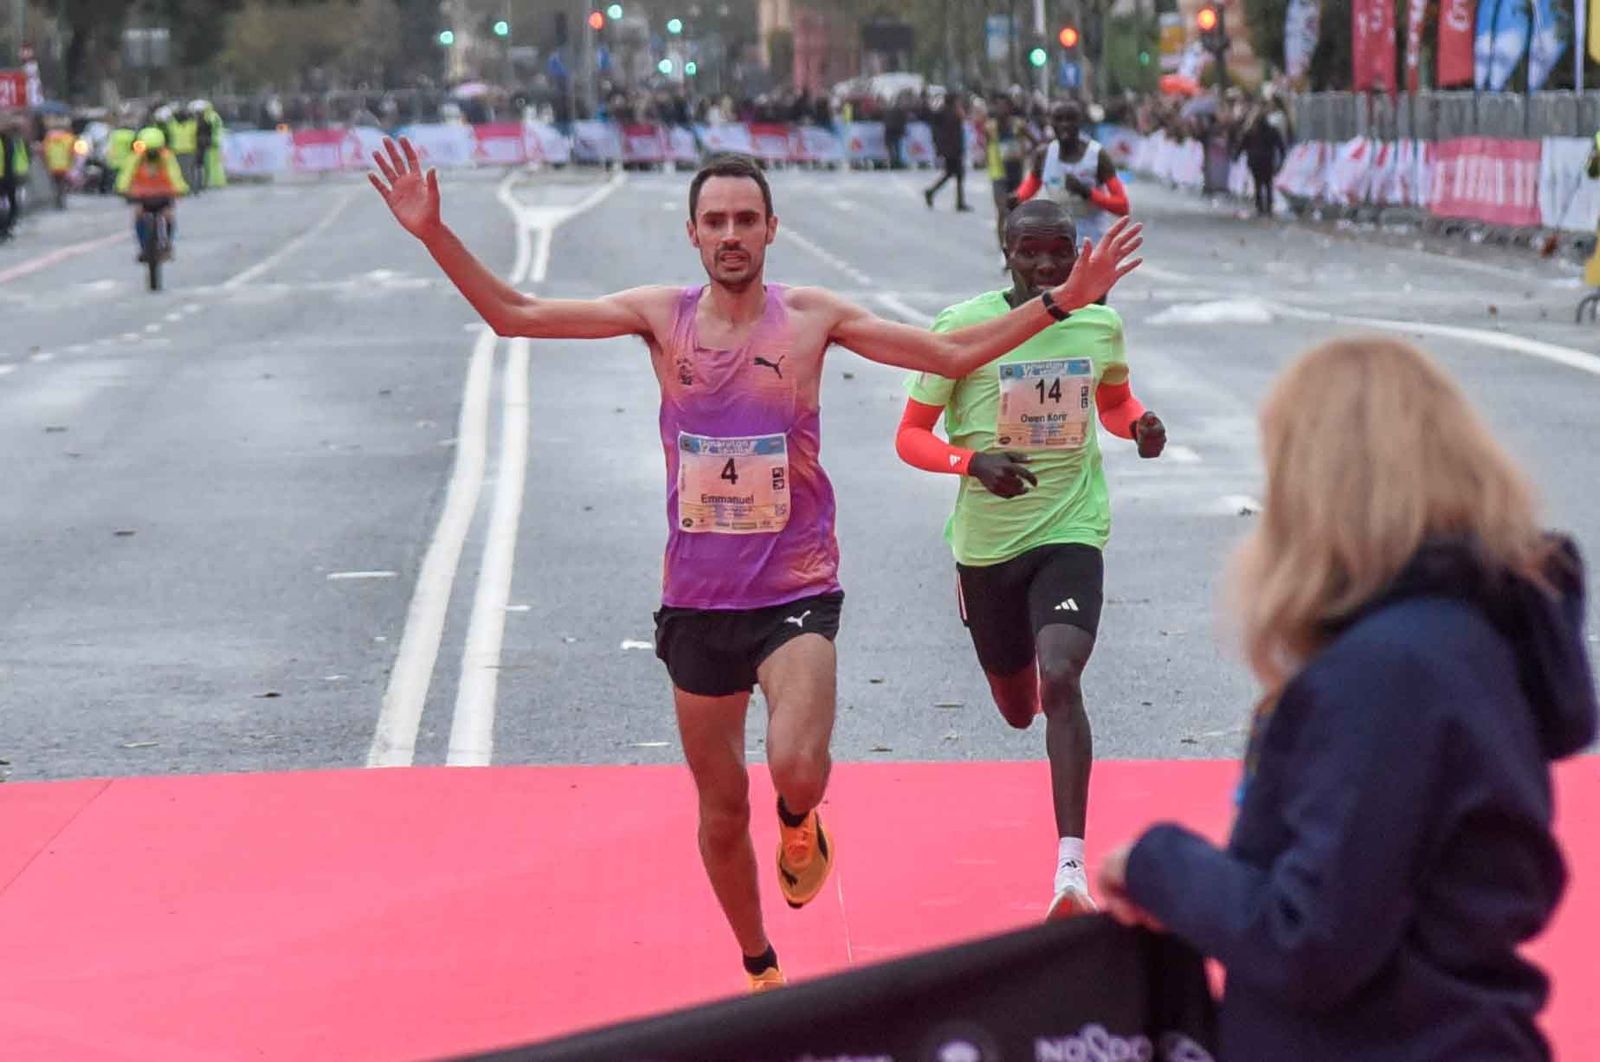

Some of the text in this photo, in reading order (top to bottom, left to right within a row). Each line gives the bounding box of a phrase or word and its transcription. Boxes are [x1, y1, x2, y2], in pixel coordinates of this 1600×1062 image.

[1035, 377, 1062, 404] 14
[1020, 413, 1046, 423] Owen
[721, 458, 738, 485] 4
[701, 493, 754, 504] Emmanuel
